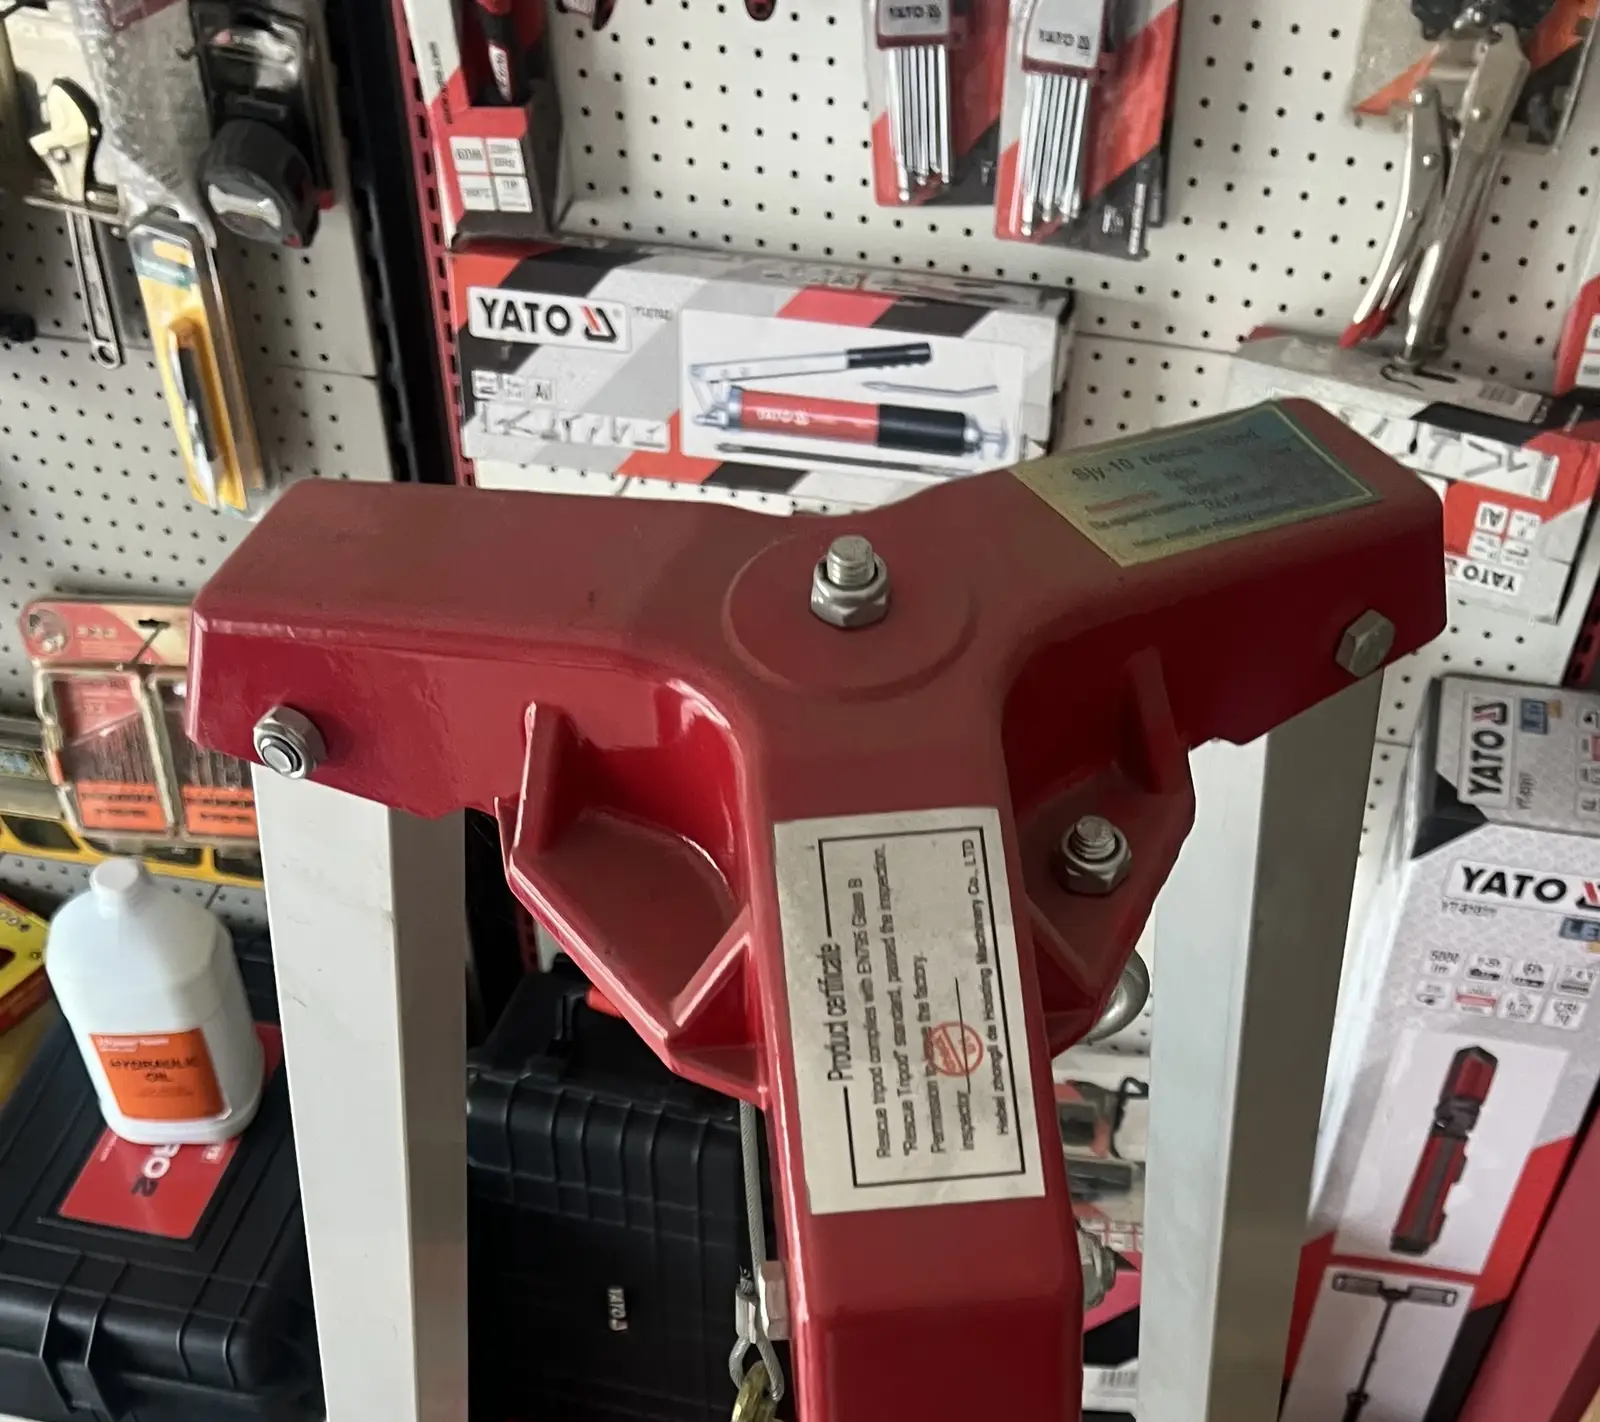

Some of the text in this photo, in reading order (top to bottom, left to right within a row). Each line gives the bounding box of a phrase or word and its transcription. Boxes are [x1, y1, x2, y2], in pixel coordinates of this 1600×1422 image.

[479, 296, 571, 337] YATO
[1463, 563, 1516, 592] YATO
[1468, 729, 1505, 795] YATO
[962, 839, 976, 866] LTD
[848, 878, 862, 888] B
[1461, 865, 1568, 904] YATO
[880, 914, 894, 933] the
[881, 937, 902, 982] passed
[860, 977, 874, 1002] with
[816, 943, 854, 1081] Product certificate
[918, 1002, 930, 1022] the
[863, 1006, 880, 1063] complies
[869, 1067, 887, 1104] tripod
[876, 1108, 891, 1158] Rescue
[928, 1081, 946, 1153] Permission
